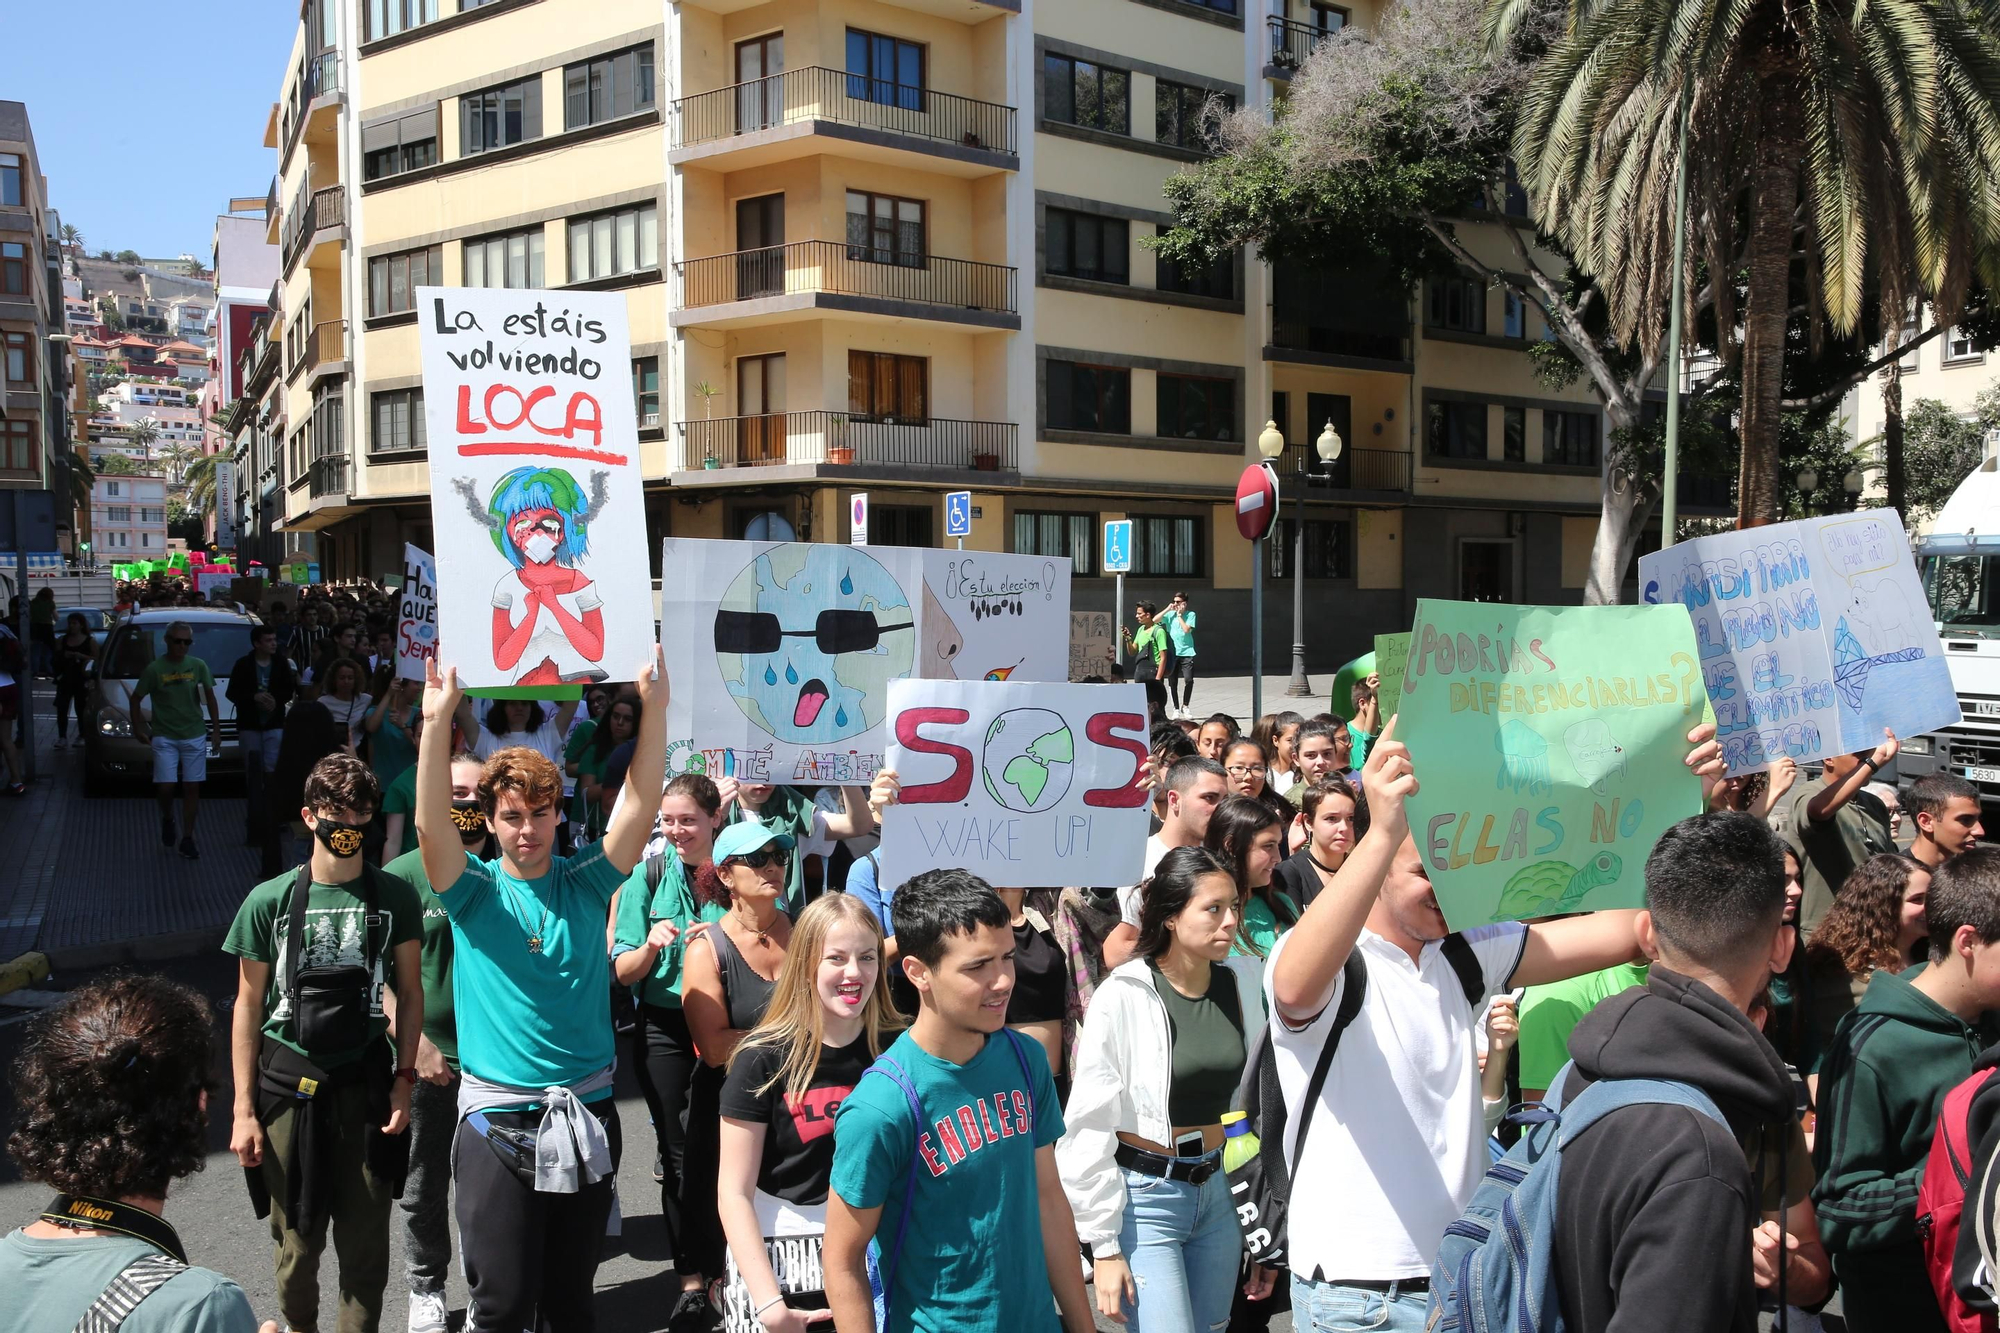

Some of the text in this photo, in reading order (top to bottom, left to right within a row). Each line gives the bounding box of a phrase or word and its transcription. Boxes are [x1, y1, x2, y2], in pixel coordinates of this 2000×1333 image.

[434, 298, 607, 343] La estáis
[446, 340, 601, 380] volviendo
[456, 383, 604, 446] LOCA
[399, 620, 440, 663] Sent
[1971, 769, 1996, 781] 5630
[914, 814, 1092, 861] WAKE UP!
[1427, 798, 1644, 871] ELLAS NO
[68, 1200, 114, 1221] Nikon
